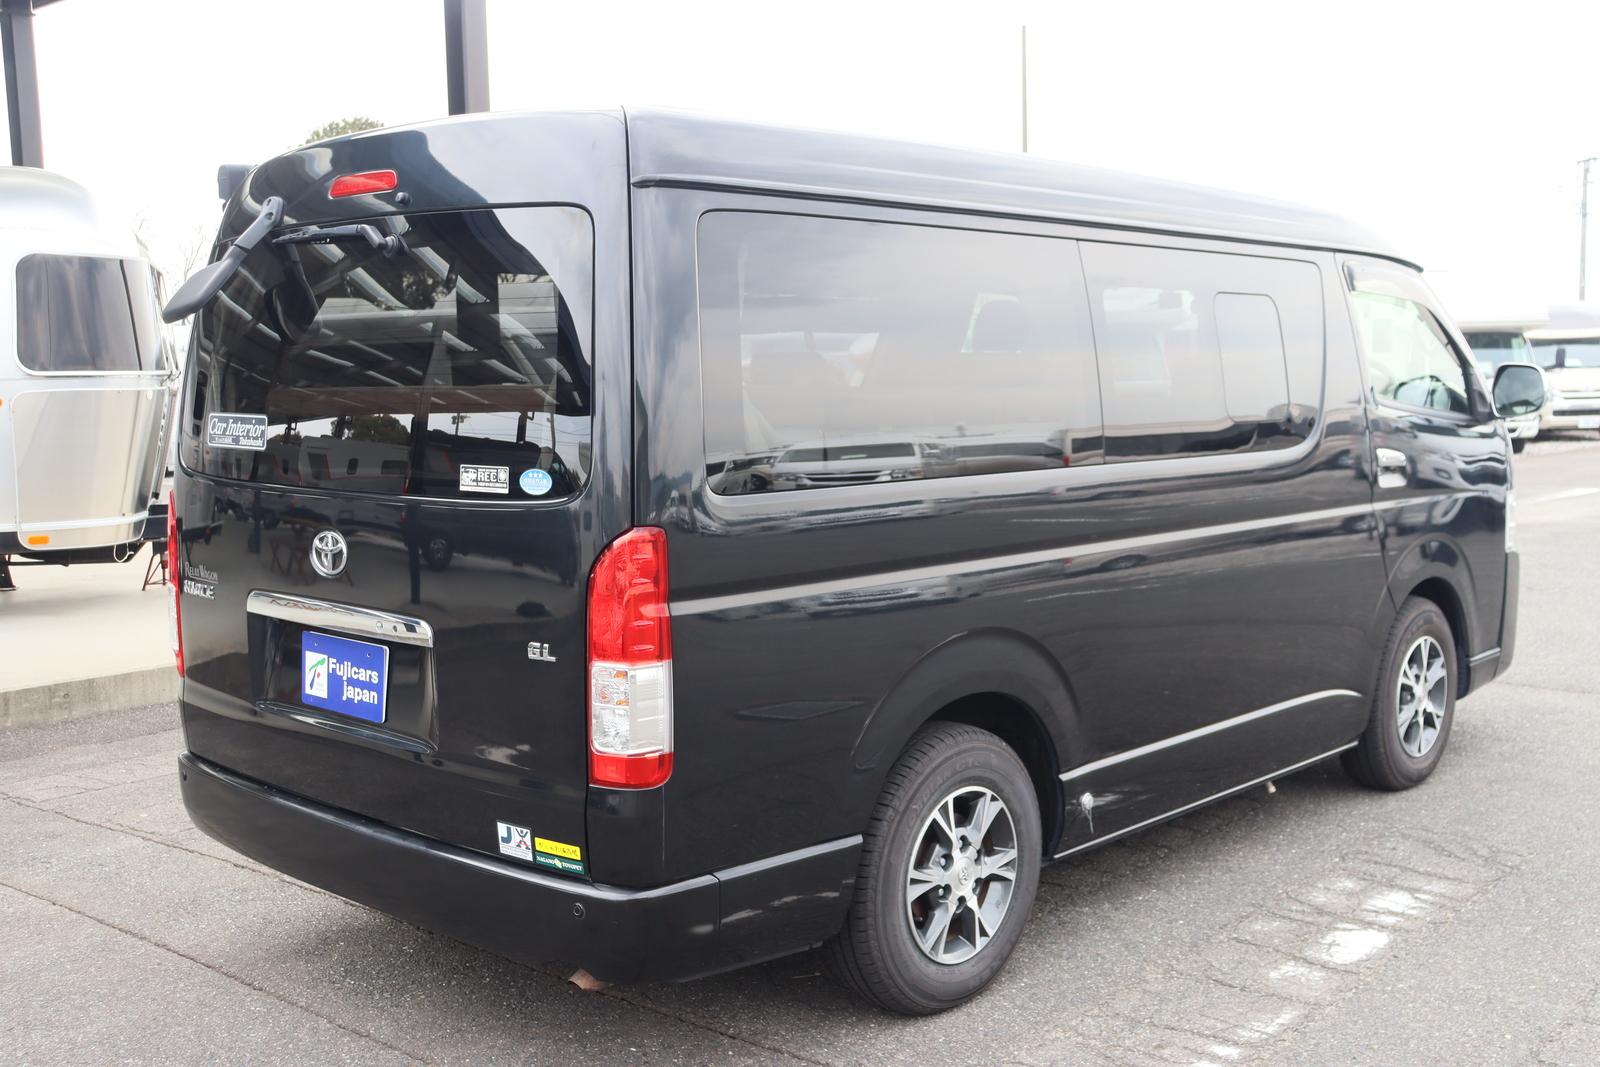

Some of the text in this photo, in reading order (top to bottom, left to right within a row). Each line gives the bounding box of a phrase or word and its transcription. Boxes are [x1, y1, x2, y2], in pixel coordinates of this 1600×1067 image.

[210, 418, 266, 437] Car Interior
[477, 471, 498, 482] REC
[527, 641, 557, 662] GL
[328, 657, 380, 684] Fujicars
[342, 680, 379, 705] japan
